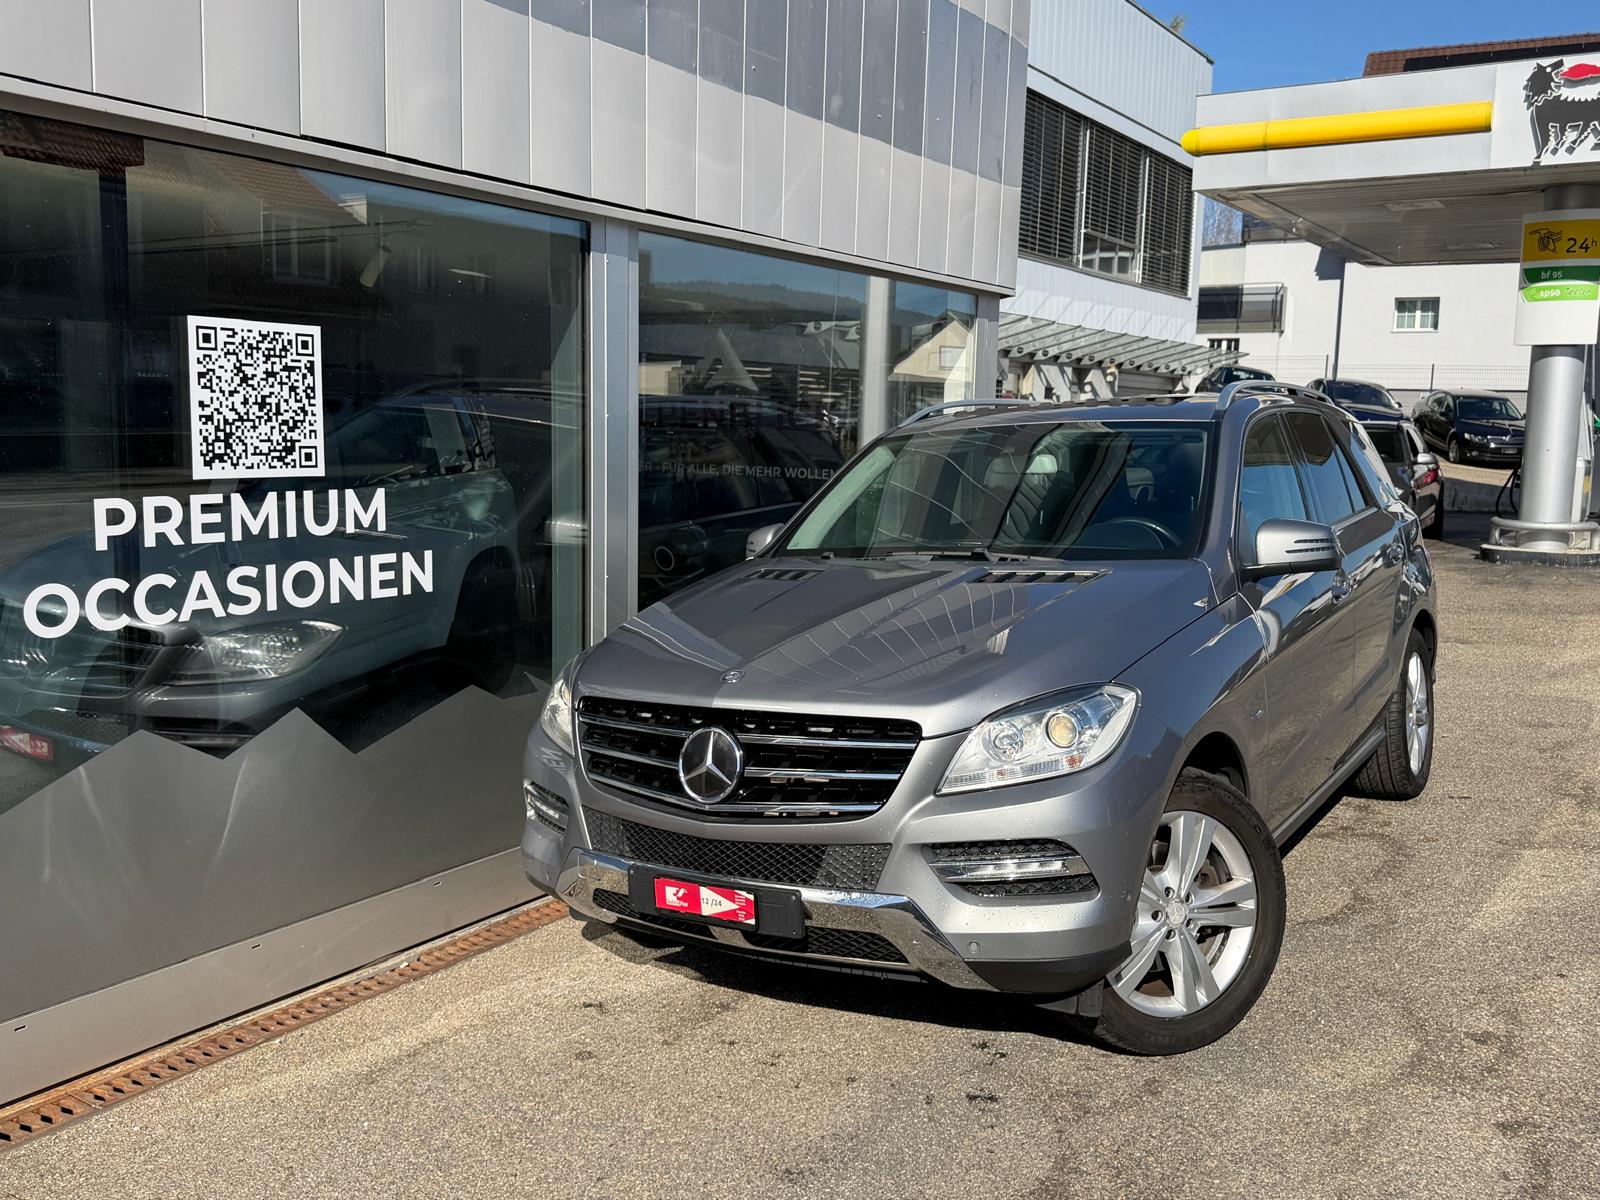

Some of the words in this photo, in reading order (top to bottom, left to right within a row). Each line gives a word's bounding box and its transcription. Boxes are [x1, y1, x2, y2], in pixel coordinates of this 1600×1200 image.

[722, 463, 744, 476] DIE
[745, 465, 781, 478] MEHR
[93, 487, 387, 551] PREMIUM
[23, 549, 434, 639] OCCASIONEN
